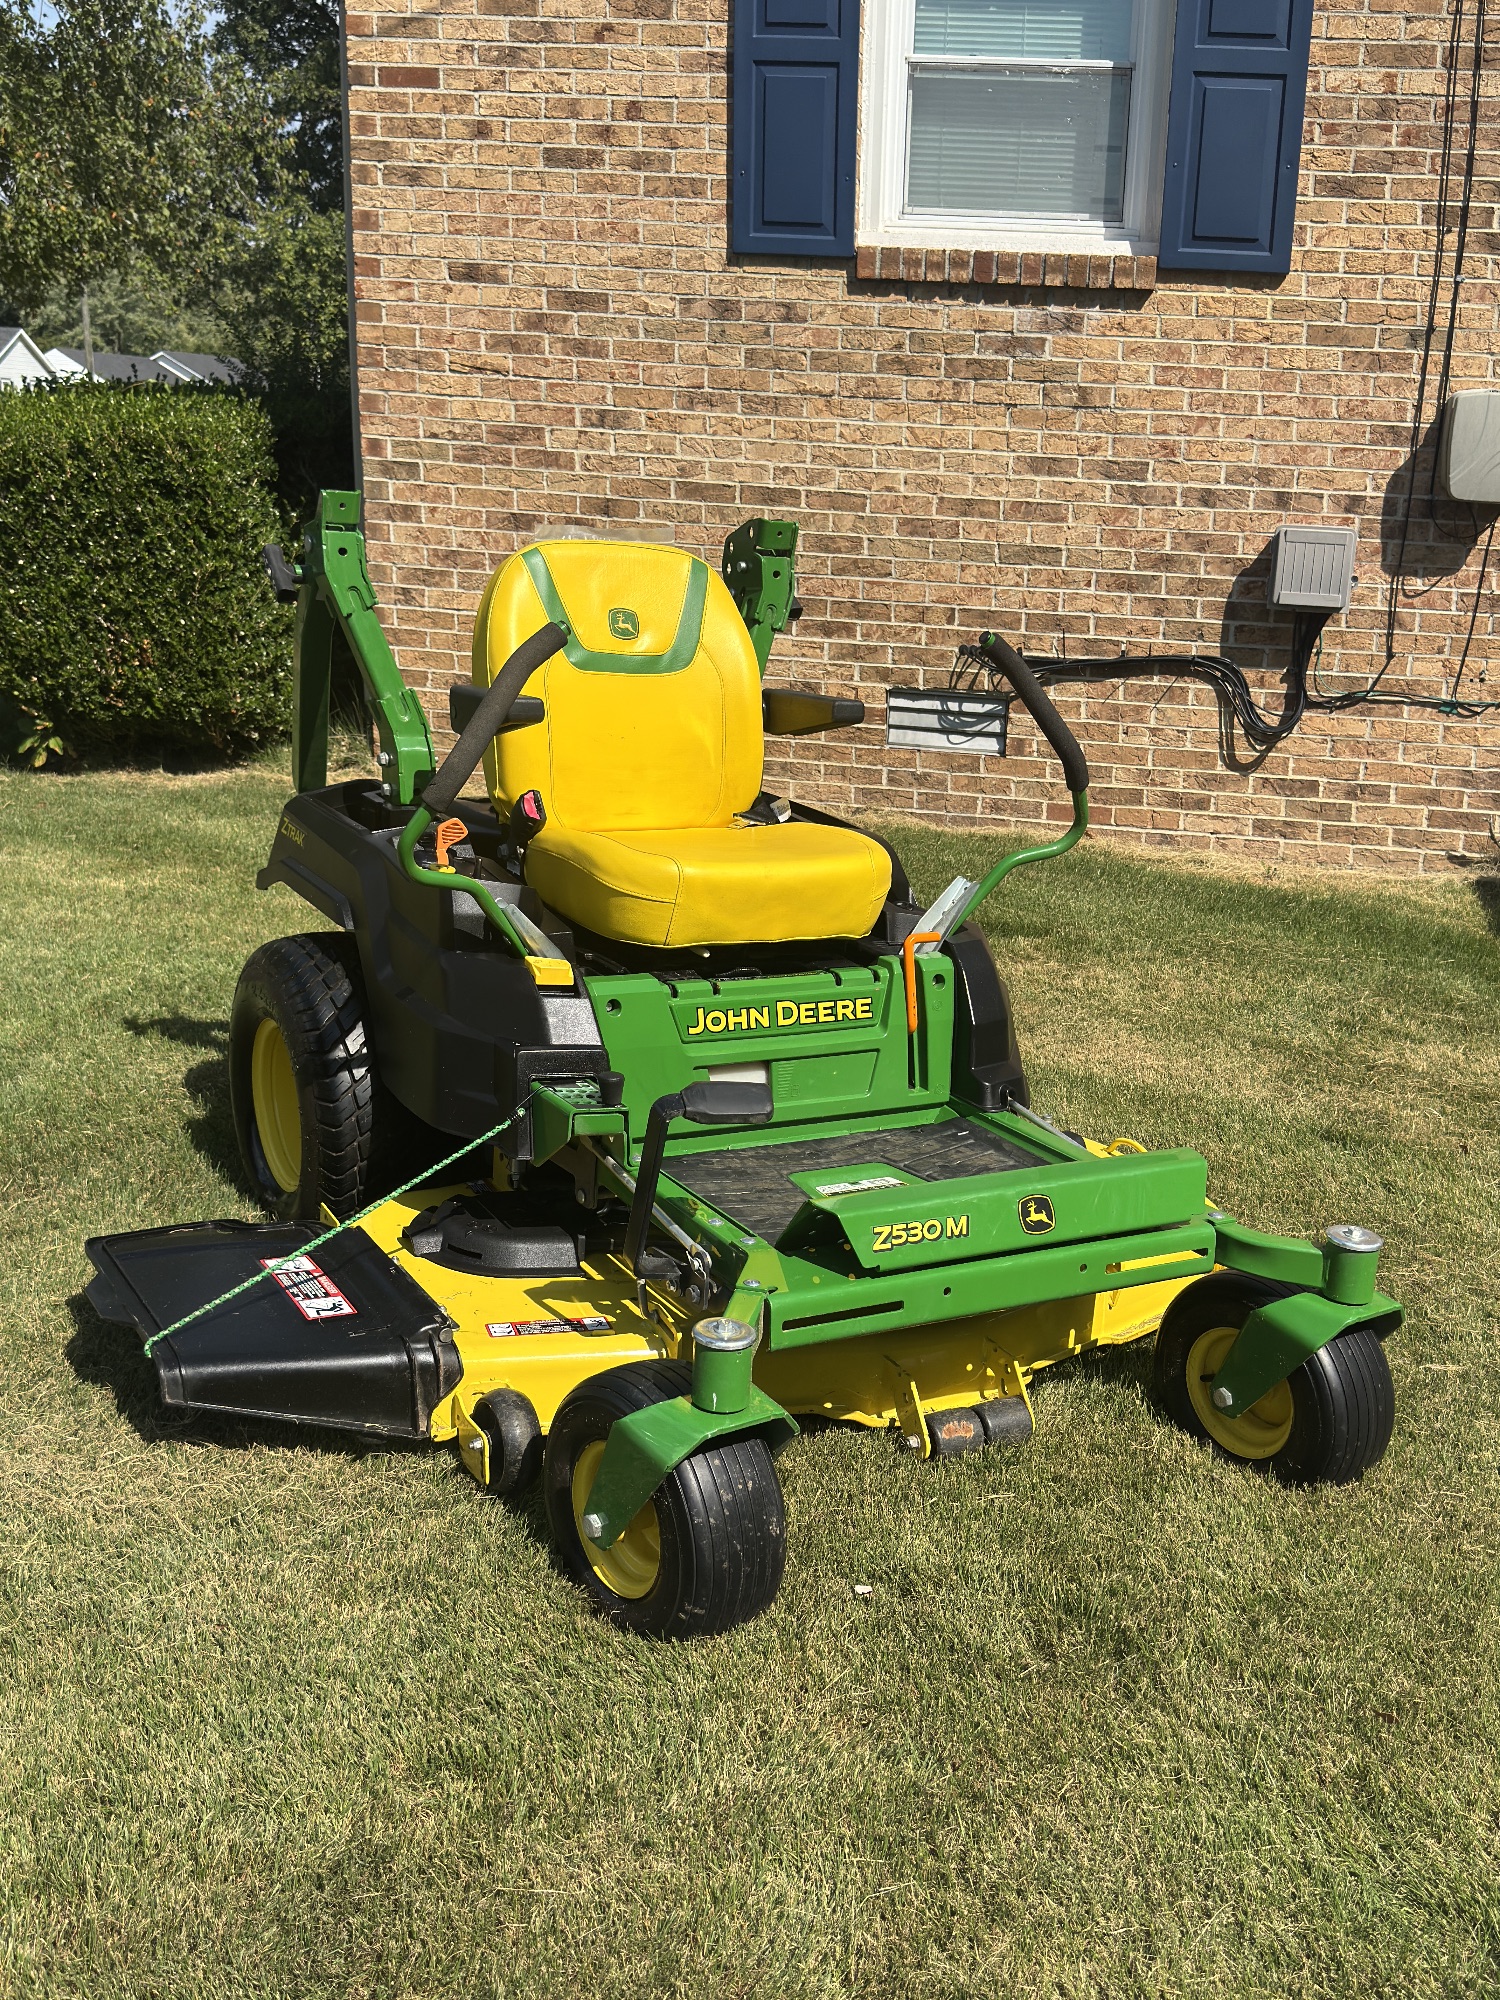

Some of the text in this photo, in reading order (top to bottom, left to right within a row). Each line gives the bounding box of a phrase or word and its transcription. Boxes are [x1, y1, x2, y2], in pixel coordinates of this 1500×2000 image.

[281, 817, 305, 847] ZTRAK
[688, 997, 873, 1035] JOHN DEERE
[872, 1215, 969, 1253] Z530 M
